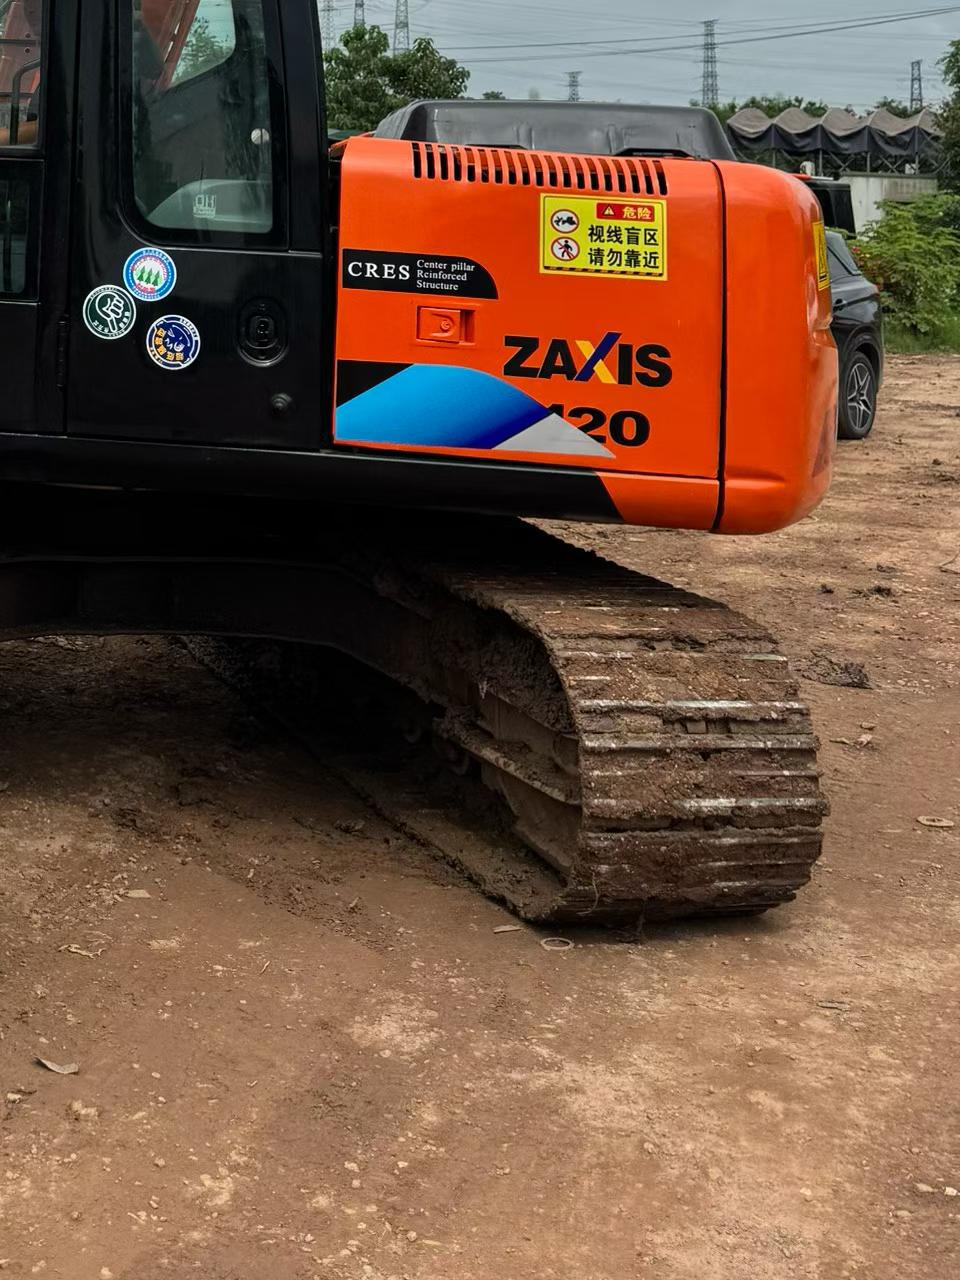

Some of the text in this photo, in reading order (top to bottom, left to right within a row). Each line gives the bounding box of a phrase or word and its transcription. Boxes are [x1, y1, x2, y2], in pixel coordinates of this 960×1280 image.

[622, 206, 652, 220] 危险
[588, 224, 659, 247] 视线盲区
[417, 259, 476, 272] Center pillar
[588, 247, 659, 269] 请勿靠近
[348, 262, 411, 280] CRES
[417, 270, 468, 281] Reinforced
[416, 279, 459, 290] Structure
[503, 331, 673, 387] ZAXIS
